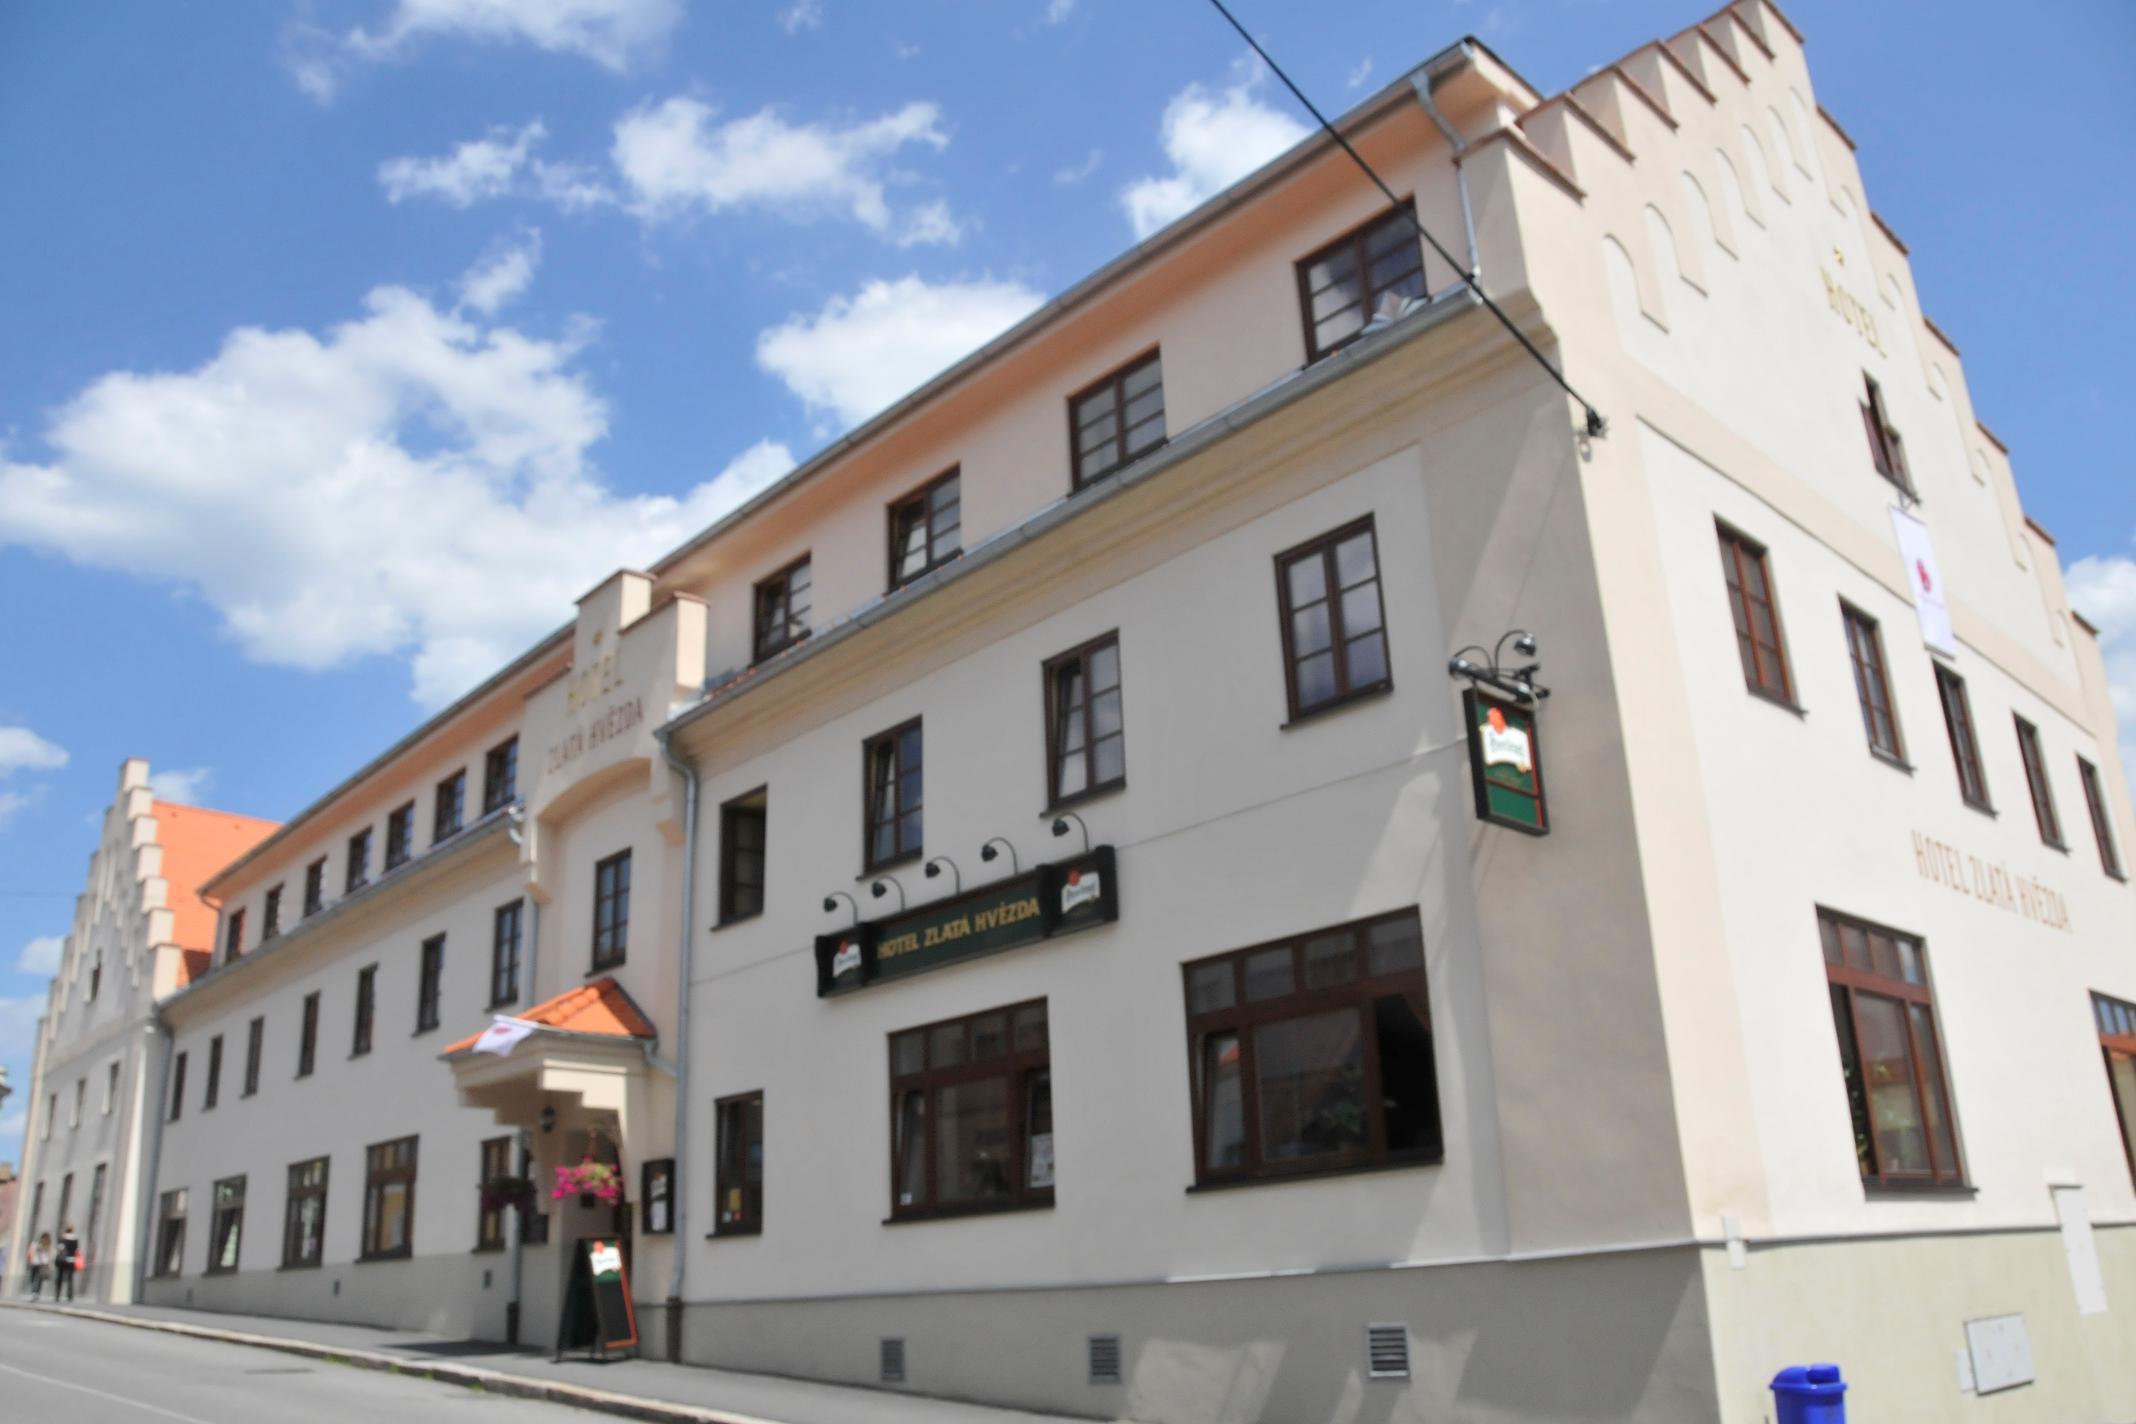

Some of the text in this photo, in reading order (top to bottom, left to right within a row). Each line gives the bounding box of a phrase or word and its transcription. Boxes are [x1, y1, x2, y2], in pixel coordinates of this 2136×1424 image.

[1819, 265, 1887, 359] HOTEL
[567, 652, 624, 715] HOTEL
[1911, 830, 1969, 895] HOTEL
[877, 932, 919, 959] HOTEL
[924, 913, 970, 947] ZLATÁ
